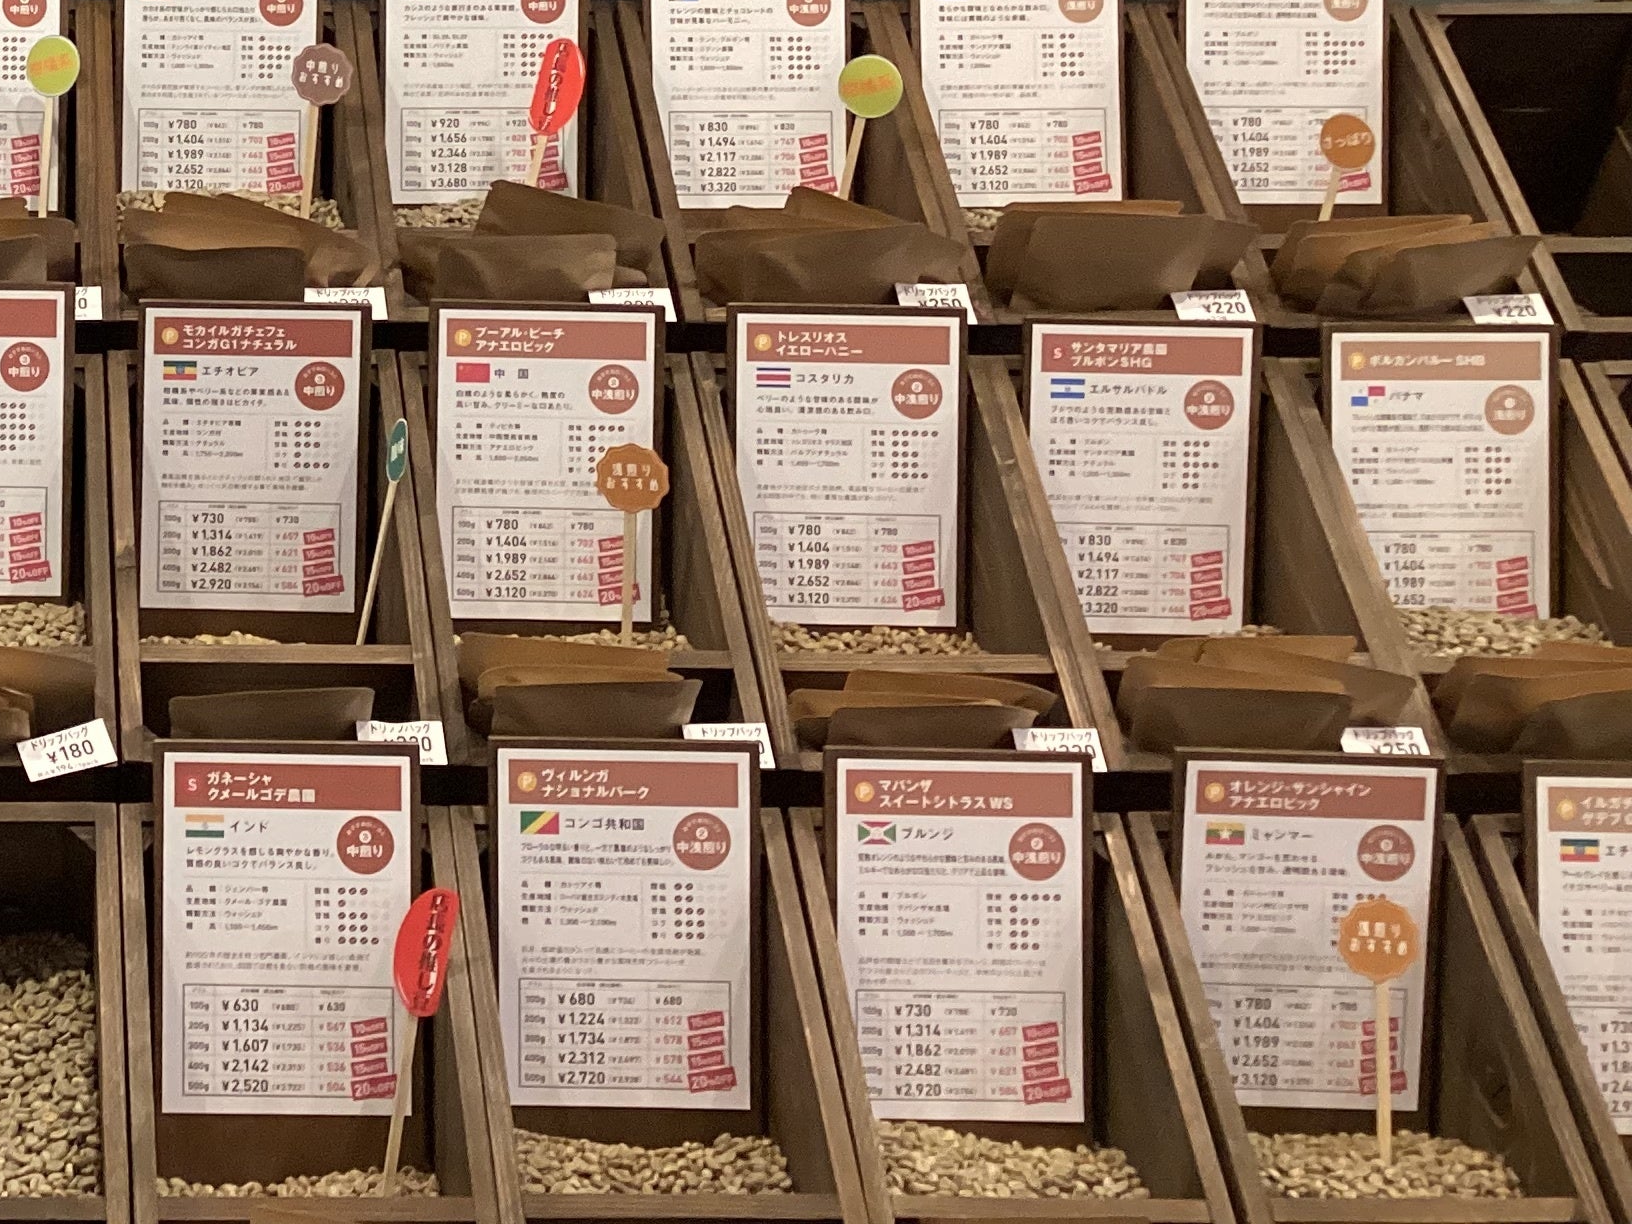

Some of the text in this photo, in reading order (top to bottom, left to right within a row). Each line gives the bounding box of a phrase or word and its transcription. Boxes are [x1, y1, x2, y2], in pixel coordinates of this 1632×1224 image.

[182, 325, 287, 339] モカイルガチェフェ
[776, 331, 847, 344] トレスリオス
[775, 345, 863, 359] イエローハニー
[795, 372, 855, 385] コスタリカ
[47, 740, 94, 763] ¥180
[208, 772, 272, 786] ガネーシャ
[879, 794, 1013, 809] スイートシトラス WS
[229, 820, 269, 833] インド
[564, 816, 645, 832] コンゴ共和国
